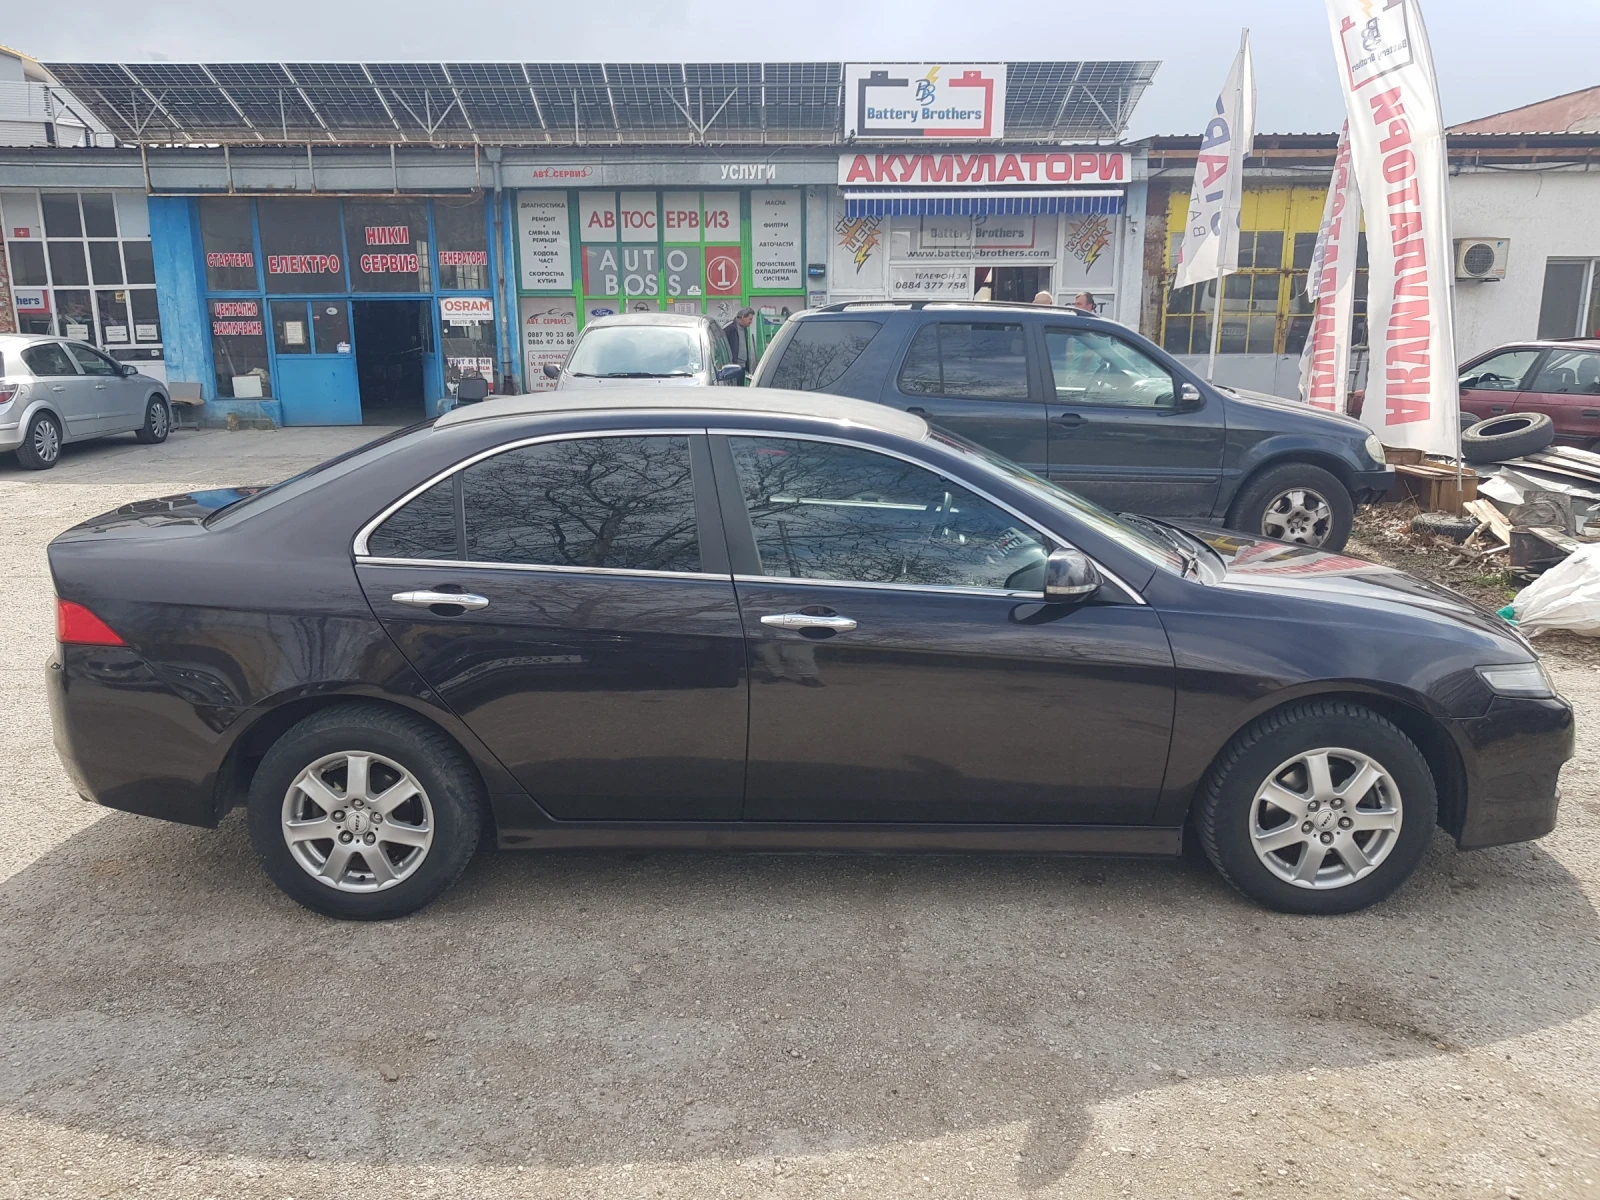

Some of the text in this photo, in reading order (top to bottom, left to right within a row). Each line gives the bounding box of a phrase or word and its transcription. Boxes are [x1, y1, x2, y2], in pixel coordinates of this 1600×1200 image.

[867, 107, 982, 122] Battery Brothers
[720, 165, 776, 180] УСЛУГИ
[846, 153, 1123, 182] АКУМУЛАТОРИ
[365, 226, 409, 245] НИКИ
[930, 228, 1025, 241] Battery Brothers
[1082, 224, 1108, 253] СИЛА
[207, 253, 253, 267] СТАРТЕРИ
[439, 251, 487, 265] ГЕНЕРАТОРИ
[599, 250, 687, 271] AUTO
[906, 249, 1050, 260] www.battery-brothers.com
[268, 255, 340, 273] ЕЛЕКТРО
[361, 254, 419, 272] СЕРВИЗ
[914, 272, 968, 280] ТЕЛЕФОН ЗА
[605, 274, 681, 295] BOSS
[895, 281, 966, 290] 0884 377 758
[214, 302, 258, 319] ЦЕНТРАЛНО
[444, 300, 490, 311] OSRAM
[213, 321, 262, 335] ЗАКЛЮЧВАНЕ
